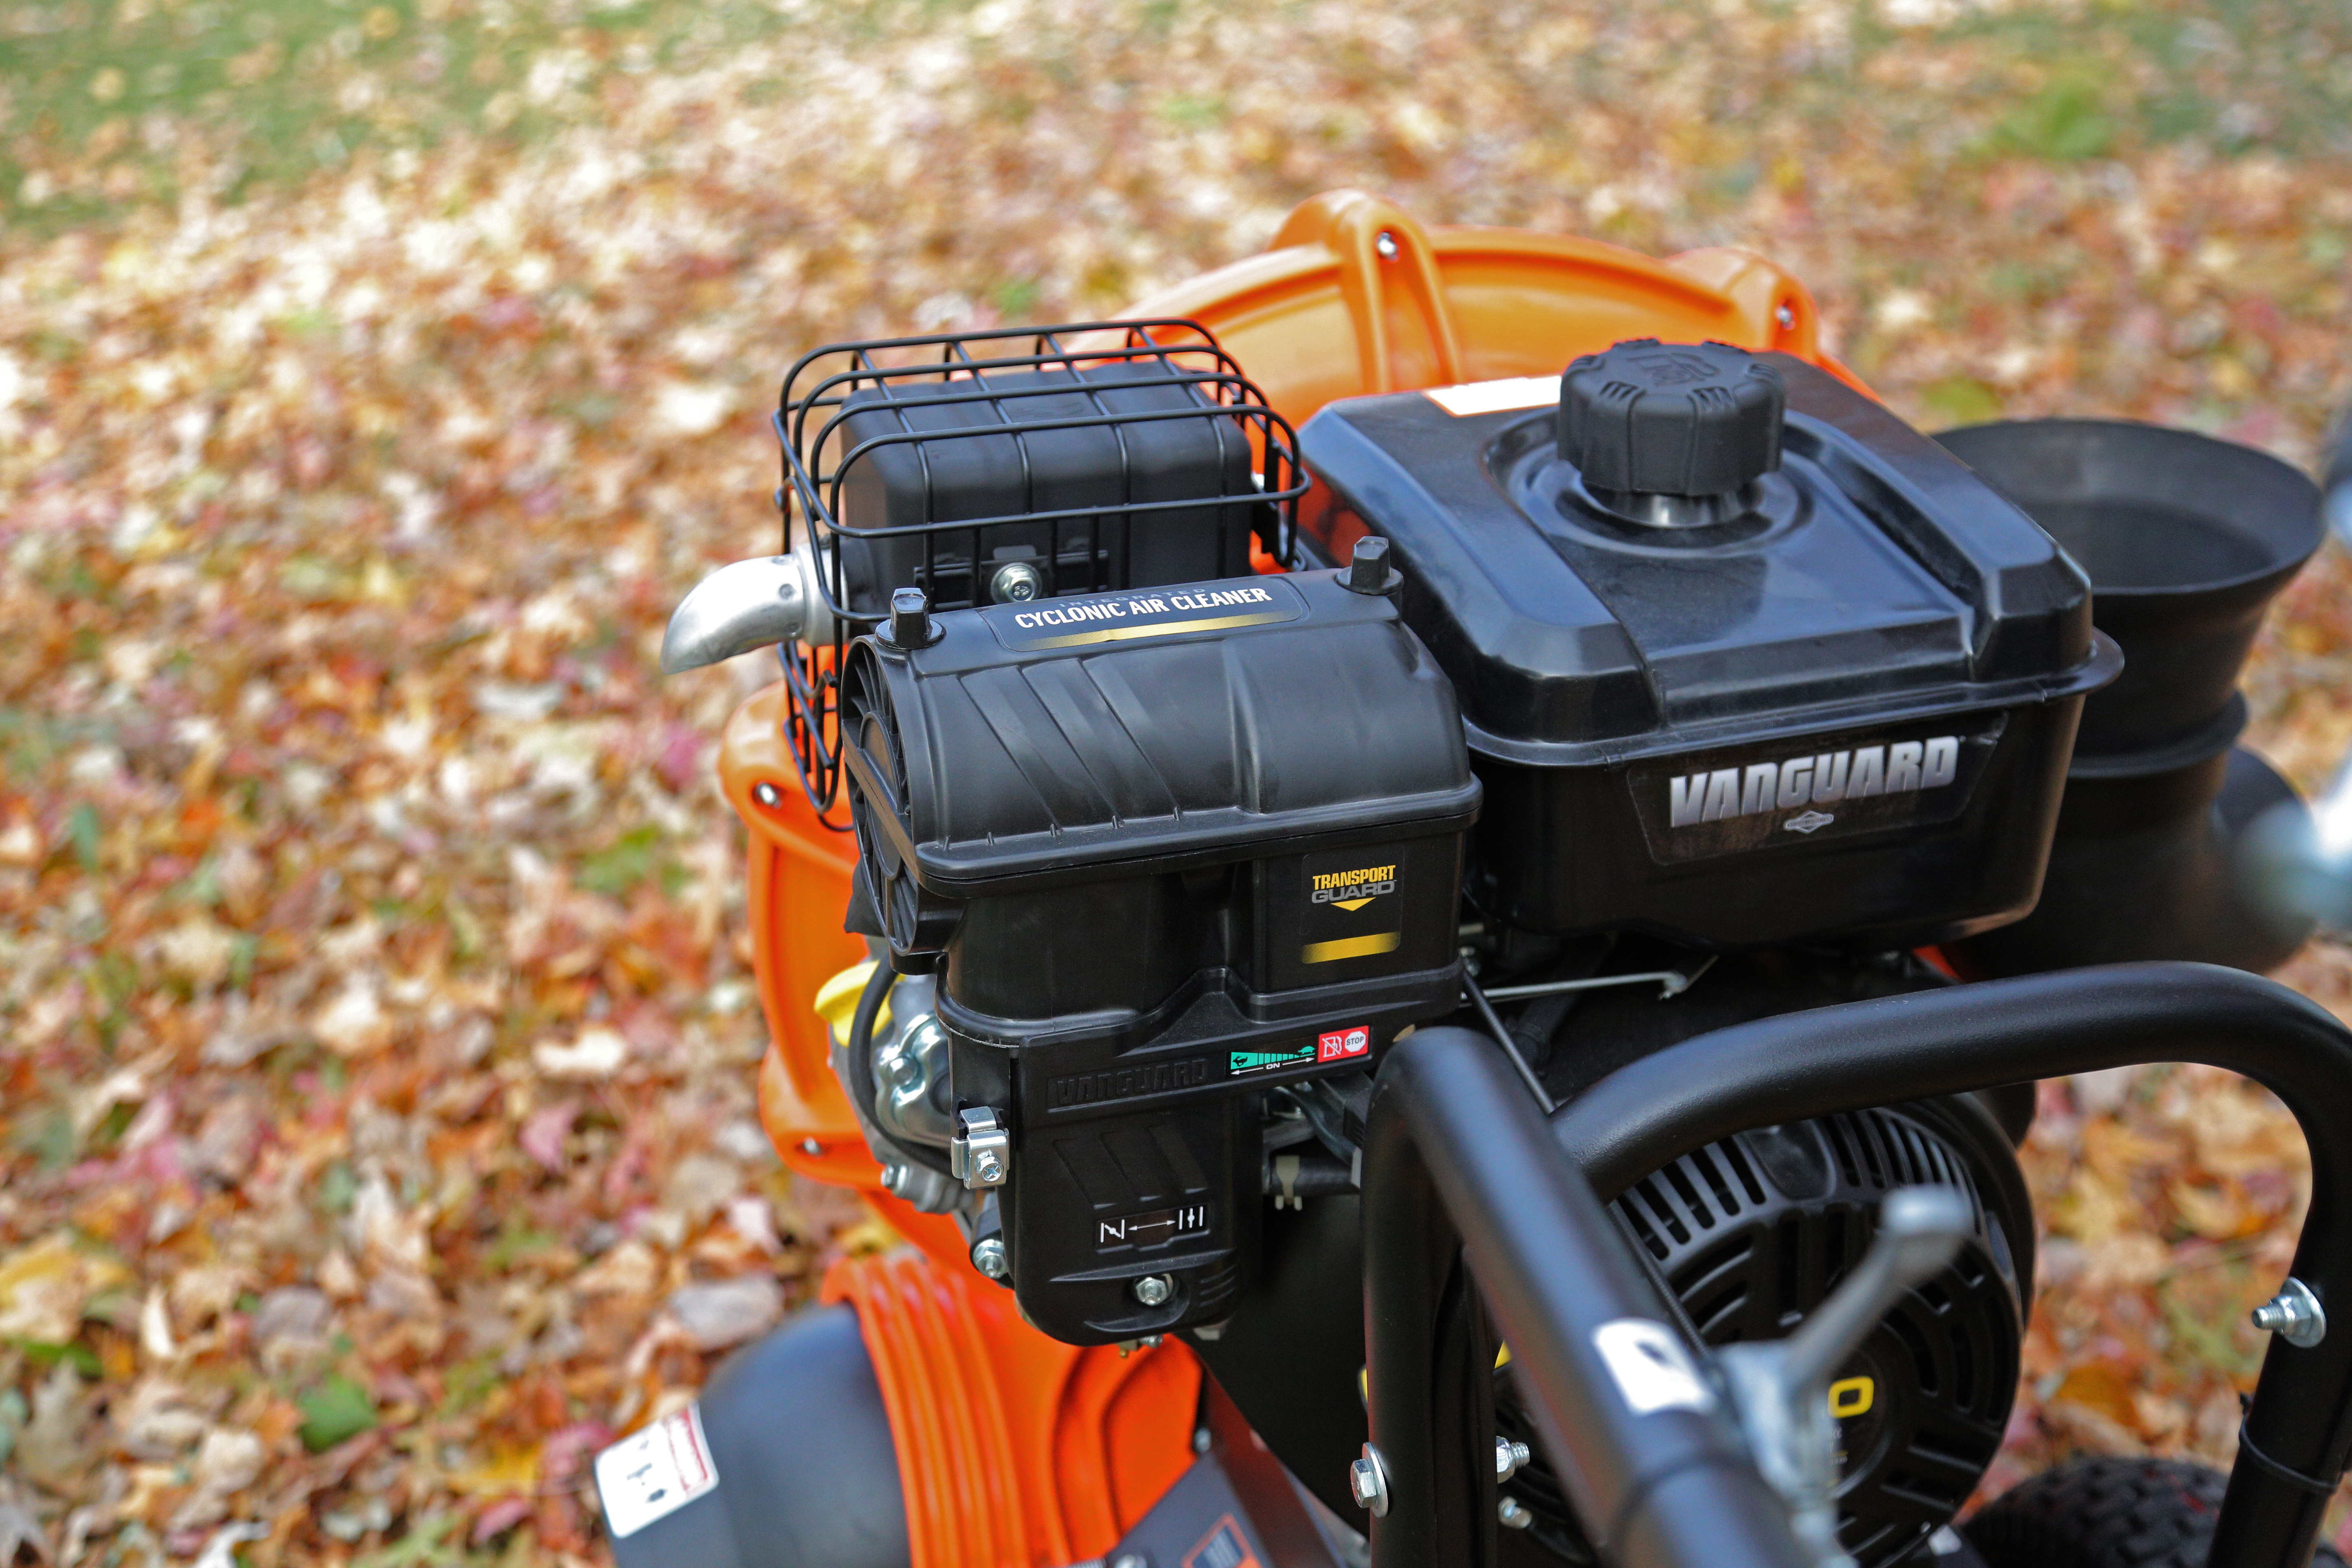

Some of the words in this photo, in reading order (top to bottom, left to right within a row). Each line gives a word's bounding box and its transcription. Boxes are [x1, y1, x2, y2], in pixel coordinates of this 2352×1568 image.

[1015, 603, 1126, 628] CYCLONIC
[1129, 599, 1170, 615] AIR
[1171, 588, 1273, 610] CLEANER
[1059, 589, 1205, 607] INTEGRATED
[1671, 736, 1958, 828] VANGUARD
[1312, 865, 1396, 891] TRANSPORT
[1312, 880, 1395, 904] GUARD
[1346, 1036, 1364, 1046] STOP
[1057, 1059, 1206, 1105] VANGUARD
